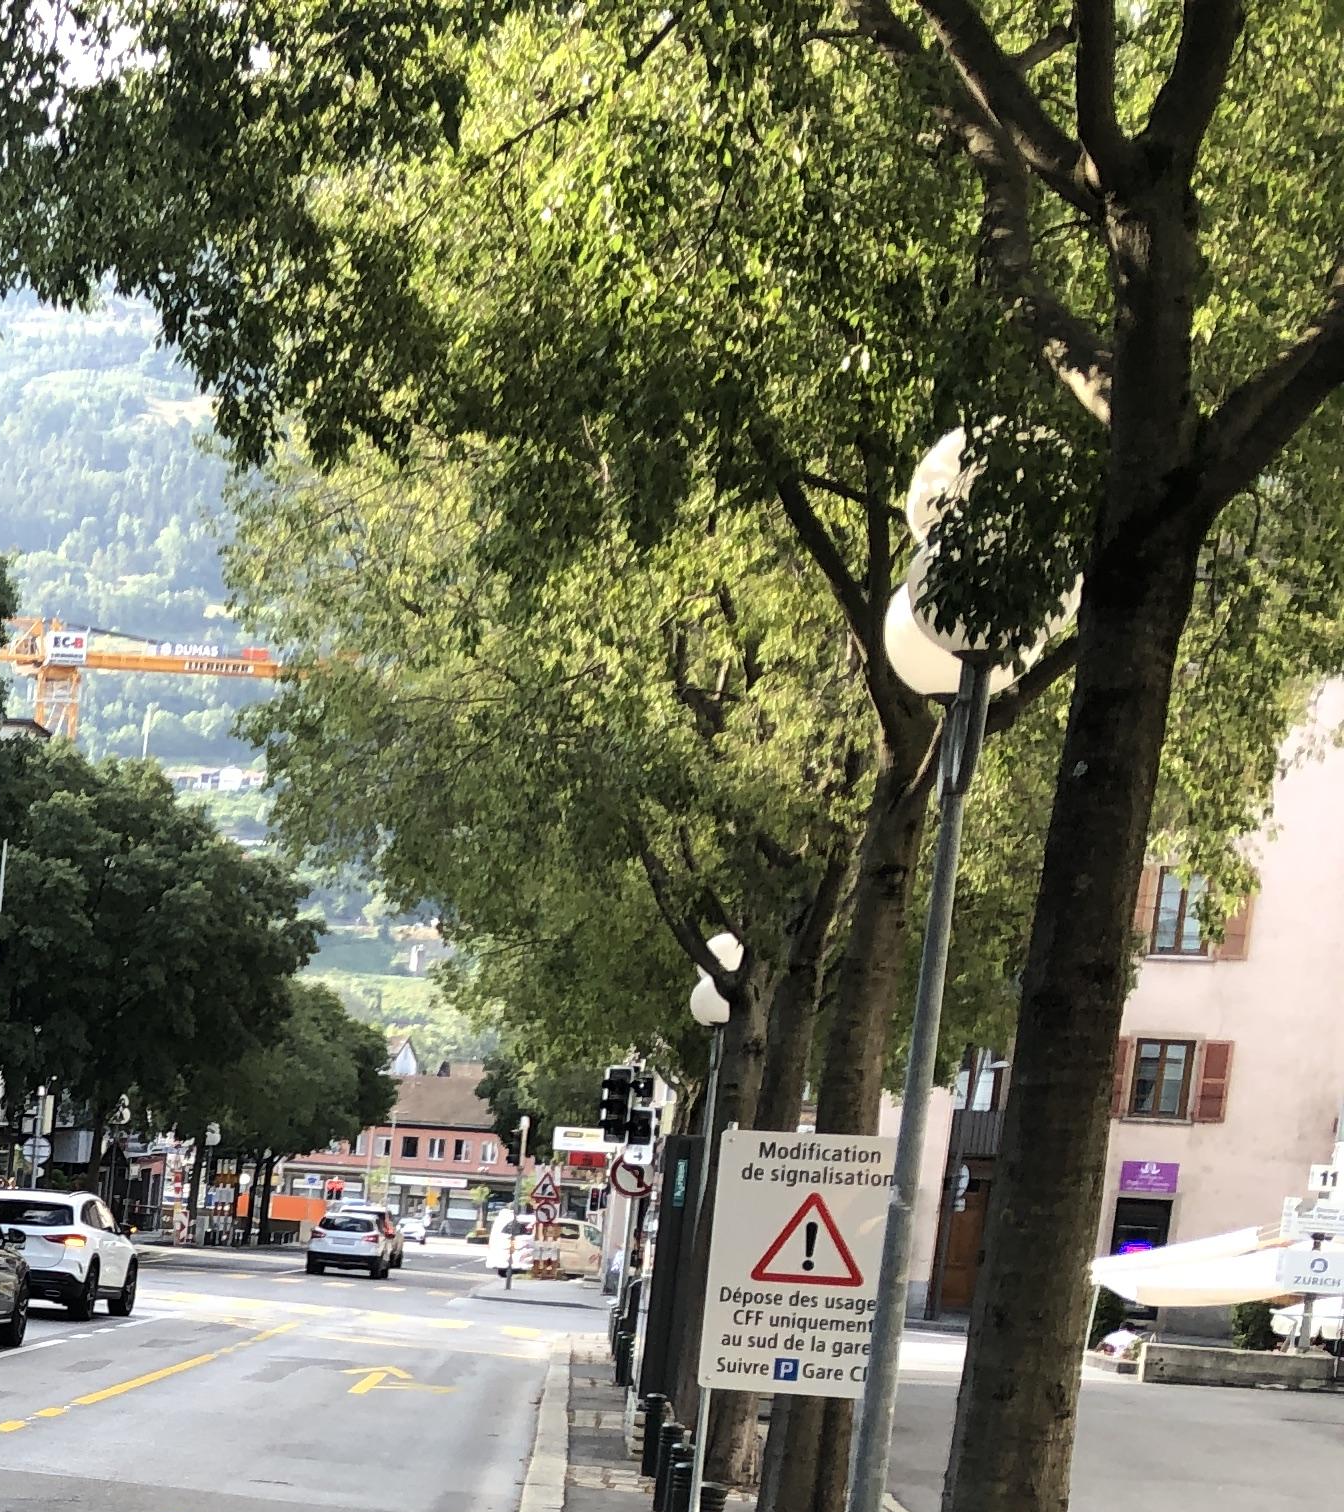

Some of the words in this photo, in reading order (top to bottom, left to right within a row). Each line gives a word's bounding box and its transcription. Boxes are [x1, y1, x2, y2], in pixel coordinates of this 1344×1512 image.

[174, 643, 219, 657] DUMAS
[759, 1141, 882, 1164] Modification
[741, 1163, 764, 1181] de
[770, 1166, 894, 1187] signalisation
[1320, 1170, 1339, 1187] 11
[1293, 1275, 1341, 1288] ZURICH
[720, 1286, 783, 1308] Dépose
[789, 1289, 818, 1308] des
[733, 1310, 764, 1326] CFF
[721, 1333, 743, 1347] au
[748, 1333, 778, 1350] sud
[784, 1334, 805, 1351] de
[812, 1336, 826, 1352] la
[832, 1341, 871, 1358] gare
[716, 1357, 770, 1376] Suivre
[802, 1363, 843, 1381] Gare
